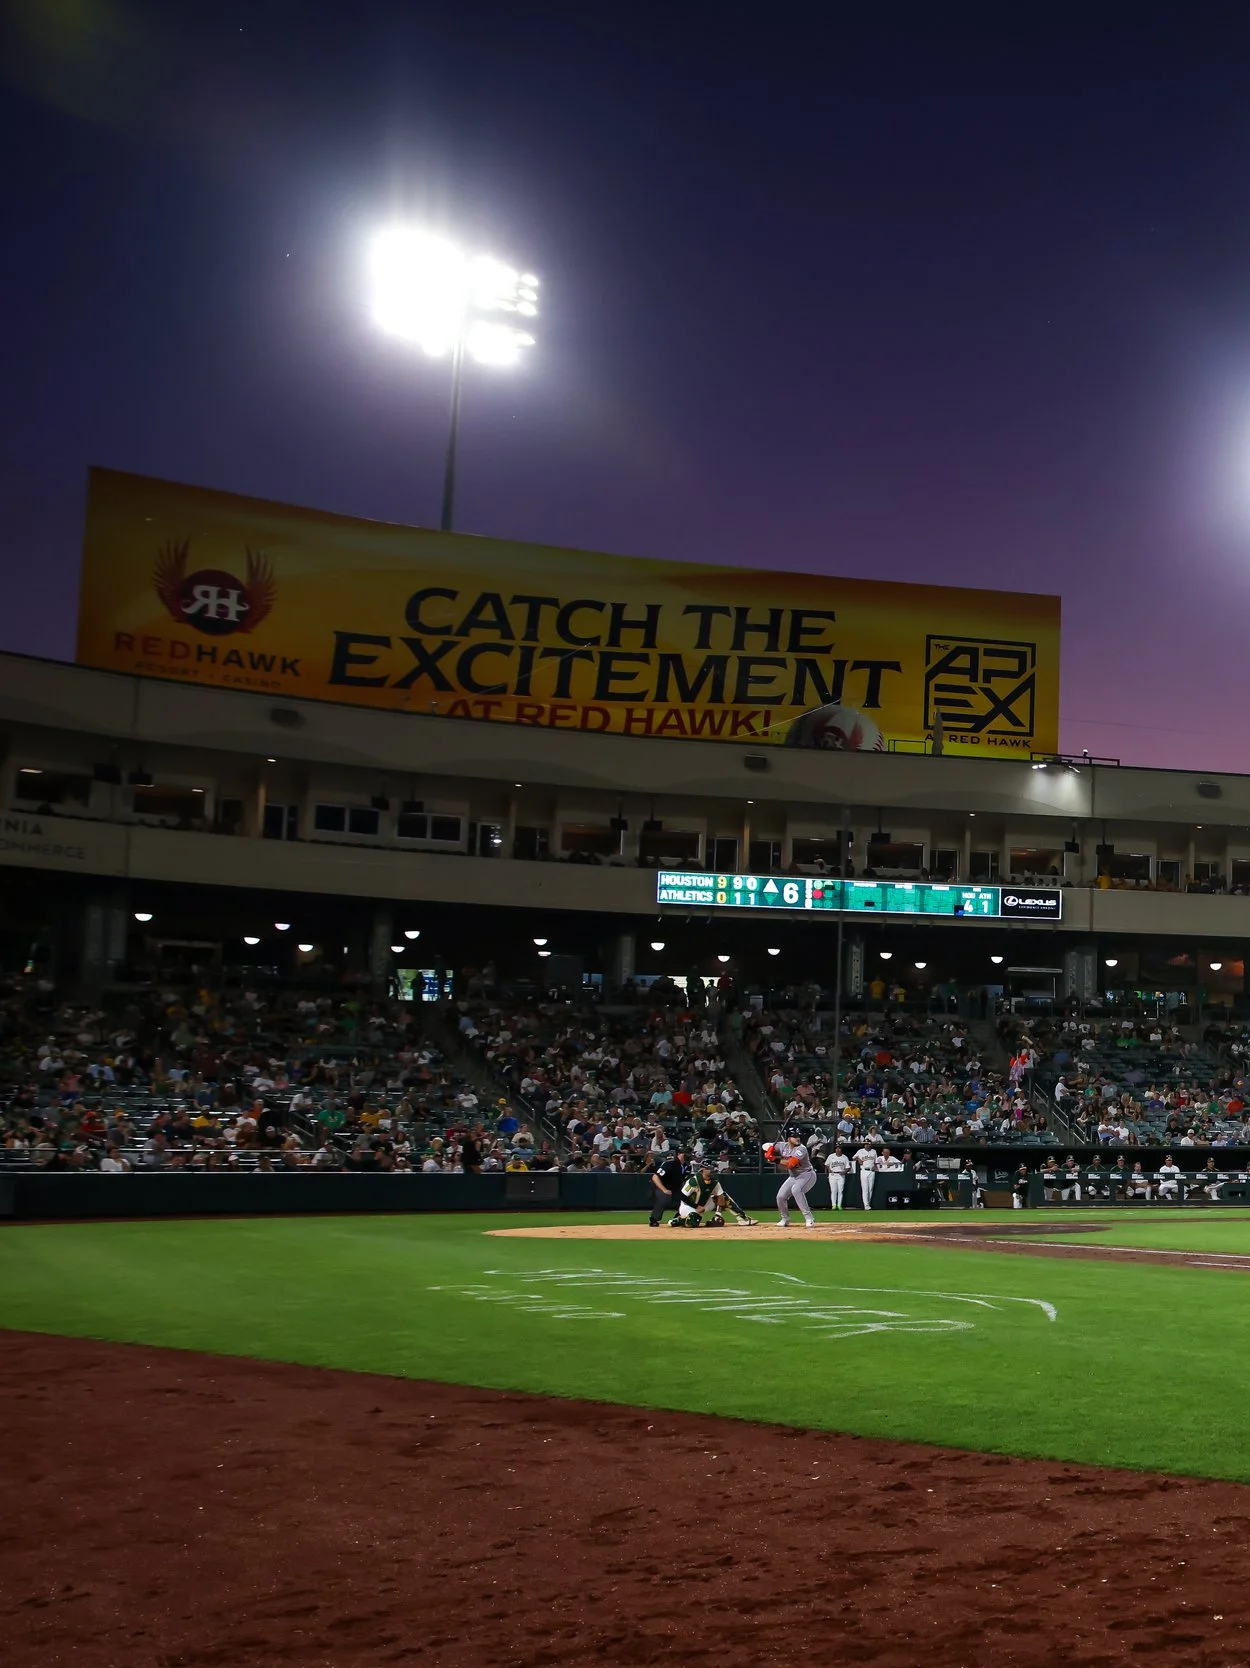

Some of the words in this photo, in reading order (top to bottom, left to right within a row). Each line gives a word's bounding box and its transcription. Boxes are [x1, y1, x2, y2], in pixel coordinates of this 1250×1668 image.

[405, 587, 662, 649] CATCH
[682, 604, 836, 654] THE
[934, 643, 951, 651] THE
[134, 660, 199, 677] RESORT
[223, 673, 282, 690] CASINO
[328, 630, 902, 709] EXCITEMENT
[515, 700, 611, 733] RED
[622, 707, 772, 739] HAWK!
[949, 734, 980, 745] RED
[987, 737, 1032, 748] HAWK
[660, 874, 713, 887] HOUSTON
[717, 876, 727, 888] 9
[733, 876, 743, 889] 9
[746, 877, 757, 890] 0
[660, 890, 713, 901] ATHLETICS
[716, 891, 727, 904] 0
[734, 892, 741, 904] 1
[748, 892, 755, 905] 1
[783, 882, 799, 904] 6
[964, 900, 973, 912] 4
[981, 901, 989, 913] 1
[1018, 898, 1057, 906] LEXUS
